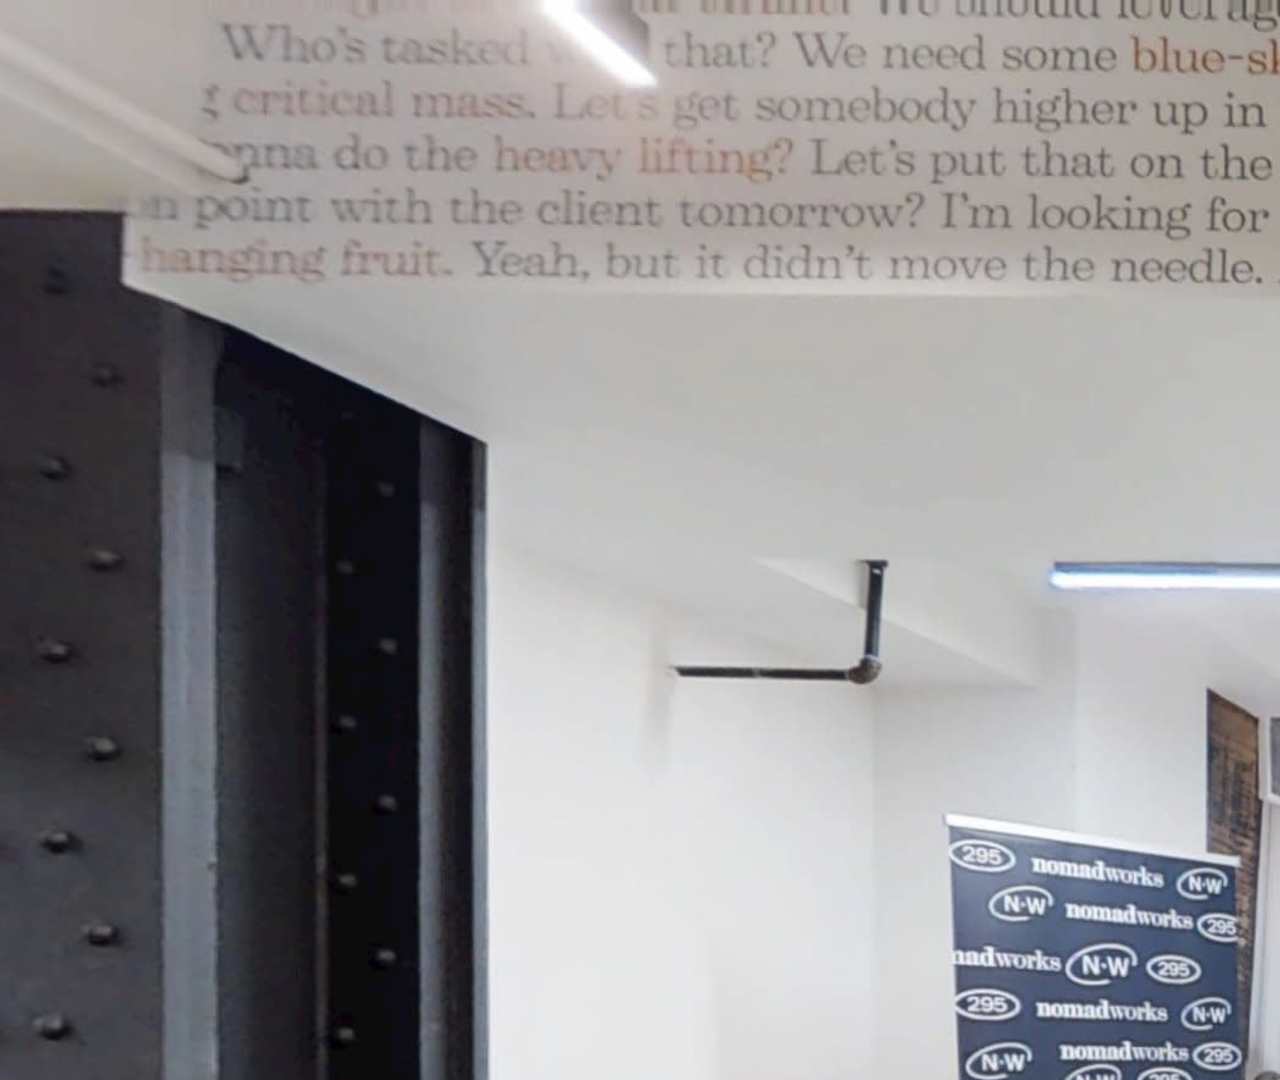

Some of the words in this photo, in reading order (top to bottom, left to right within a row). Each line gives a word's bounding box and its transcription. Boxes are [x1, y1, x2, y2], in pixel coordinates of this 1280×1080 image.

[664, 29, 777, 70] that?
[794, 30, 867, 71] We
[883, 31, 987, 73] need
[1002, 45, 1117, 75] some
[674, 88, 738, 133] get
[755, 84, 977, 136] somebody
[993, 86, 1138, 138] higher
[1153, 100, 1209, 138] up
[1224, 89, 1267, 129] in
[332, 132, 389, 172] do
[403, 133, 478, 173] the
[811, 137, 916, 178] Let's
[930, 143, 1007, 189] put
[1023, 139, 1115, 180] that
[1130, 152, 1184, 181] on
[1200, 141, 1273, 182] the
[194, 181, 312, 233] point
[330, 183, 433, 225] with
[450, 185, 523, 226] the
[536, 186, 660, 228] client
[679, 188, 925, 231] tomorrow?
[943, 191, 1013, 232] I'm
[1029, 192, 1192, 243] looking
[1208, 194, 1270, 234] for
[471, 239, 591, 286] Yeah,
[606, 240, 675, 281] but
[696, 241, 724, 281] it
[743, 241, 873, 282] didn't
[888, 254, 1007, 284] move
[1023, 244, 1095, 285] the
[1111, 245, 1263, 287] needle.
[961, 845, 1002, 866] 295
[1030, 855, 1164, 888] nomadworks
[1064, 901, 1194, 930] nomadworks
[1207, 918, 1237, 936] 295
[1157, 960, 1191, 977] 295
[967, 996, 1008, 1013] 295
[1035, 999, 1169, 1022] nomadworks
[1059, 1041, 1190, 1062] nomadworks
[1203, 1048, 1234, 1063] 295
